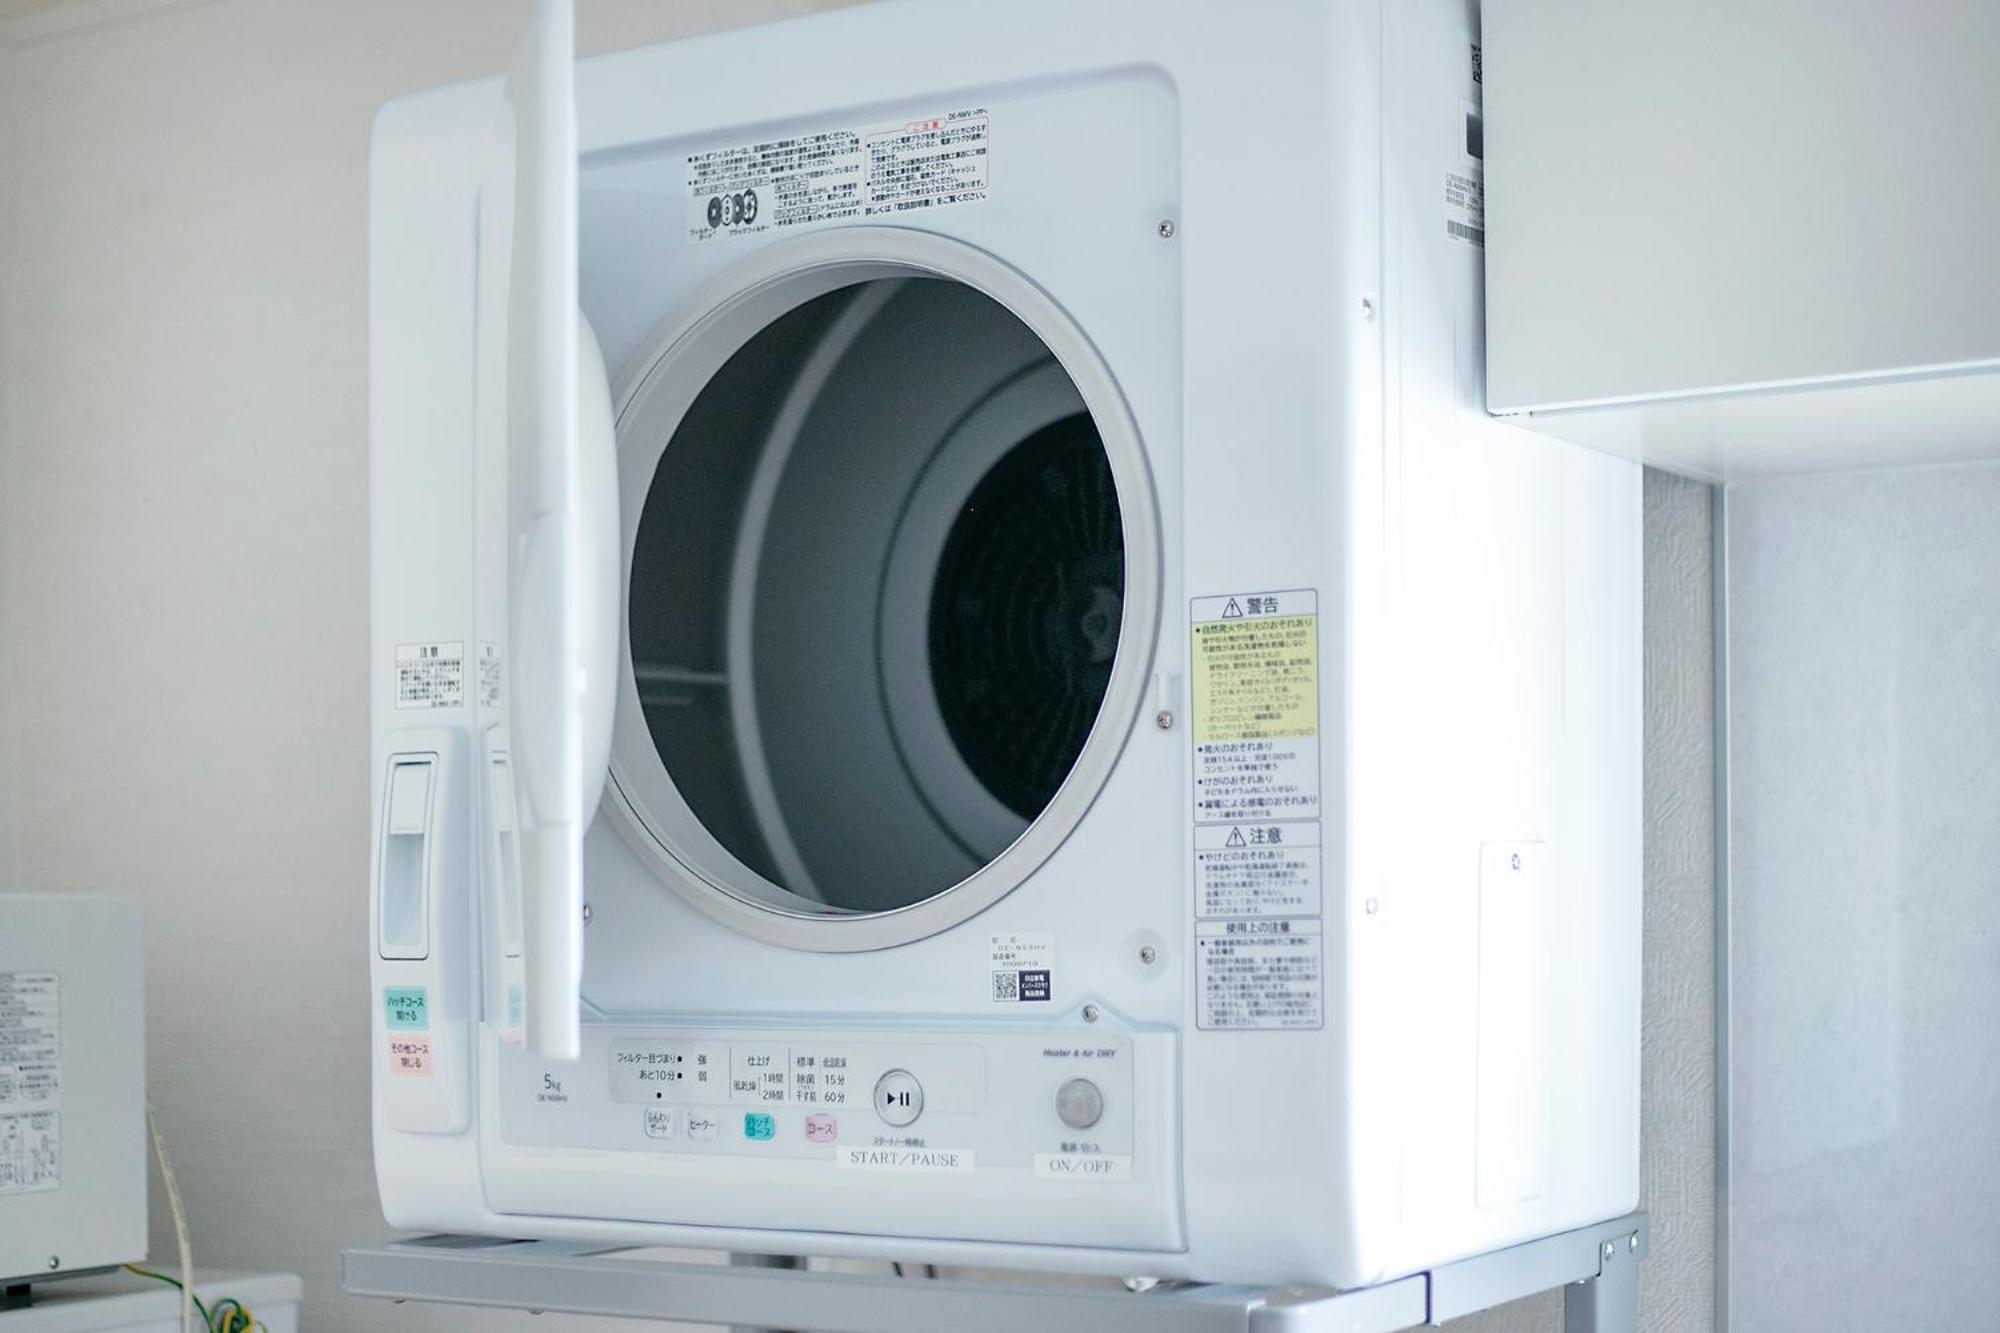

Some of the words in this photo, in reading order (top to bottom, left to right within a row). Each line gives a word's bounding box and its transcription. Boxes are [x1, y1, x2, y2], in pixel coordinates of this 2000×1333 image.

[1247, 596, 1279, 615] 警告
[1204, 742, 1273, 754] 発火のおそれあり
[1204, 775, 1274, 786] けがのおそれあり
[1249, 827, 1282, 845] 注意
[1205, 851, 1285, 861] やけどのおそれあり
[1226, 921, 1290, 934] 使用上の注意
[388, 997, 425, 1009] ハッチコース
[391, 1043, 429, 1055] その他コース
[617, 1052, 676, 1063] フィルター目づまり
[747, 1056, 771, 1066] 仕上げ
[639, 1070, 676, 1081] あと10分
[824, 1074, 845, 1086] 15分
[824, 1091, 845, 1103] 60分
[690, 1119, 716, 1131] ヒーター
[807, 1122, 834, 1134] コース
[850, 1151, 959, 1168] START/PAUSE
[1049, 1159, 1115, 1173] ON/OFF
